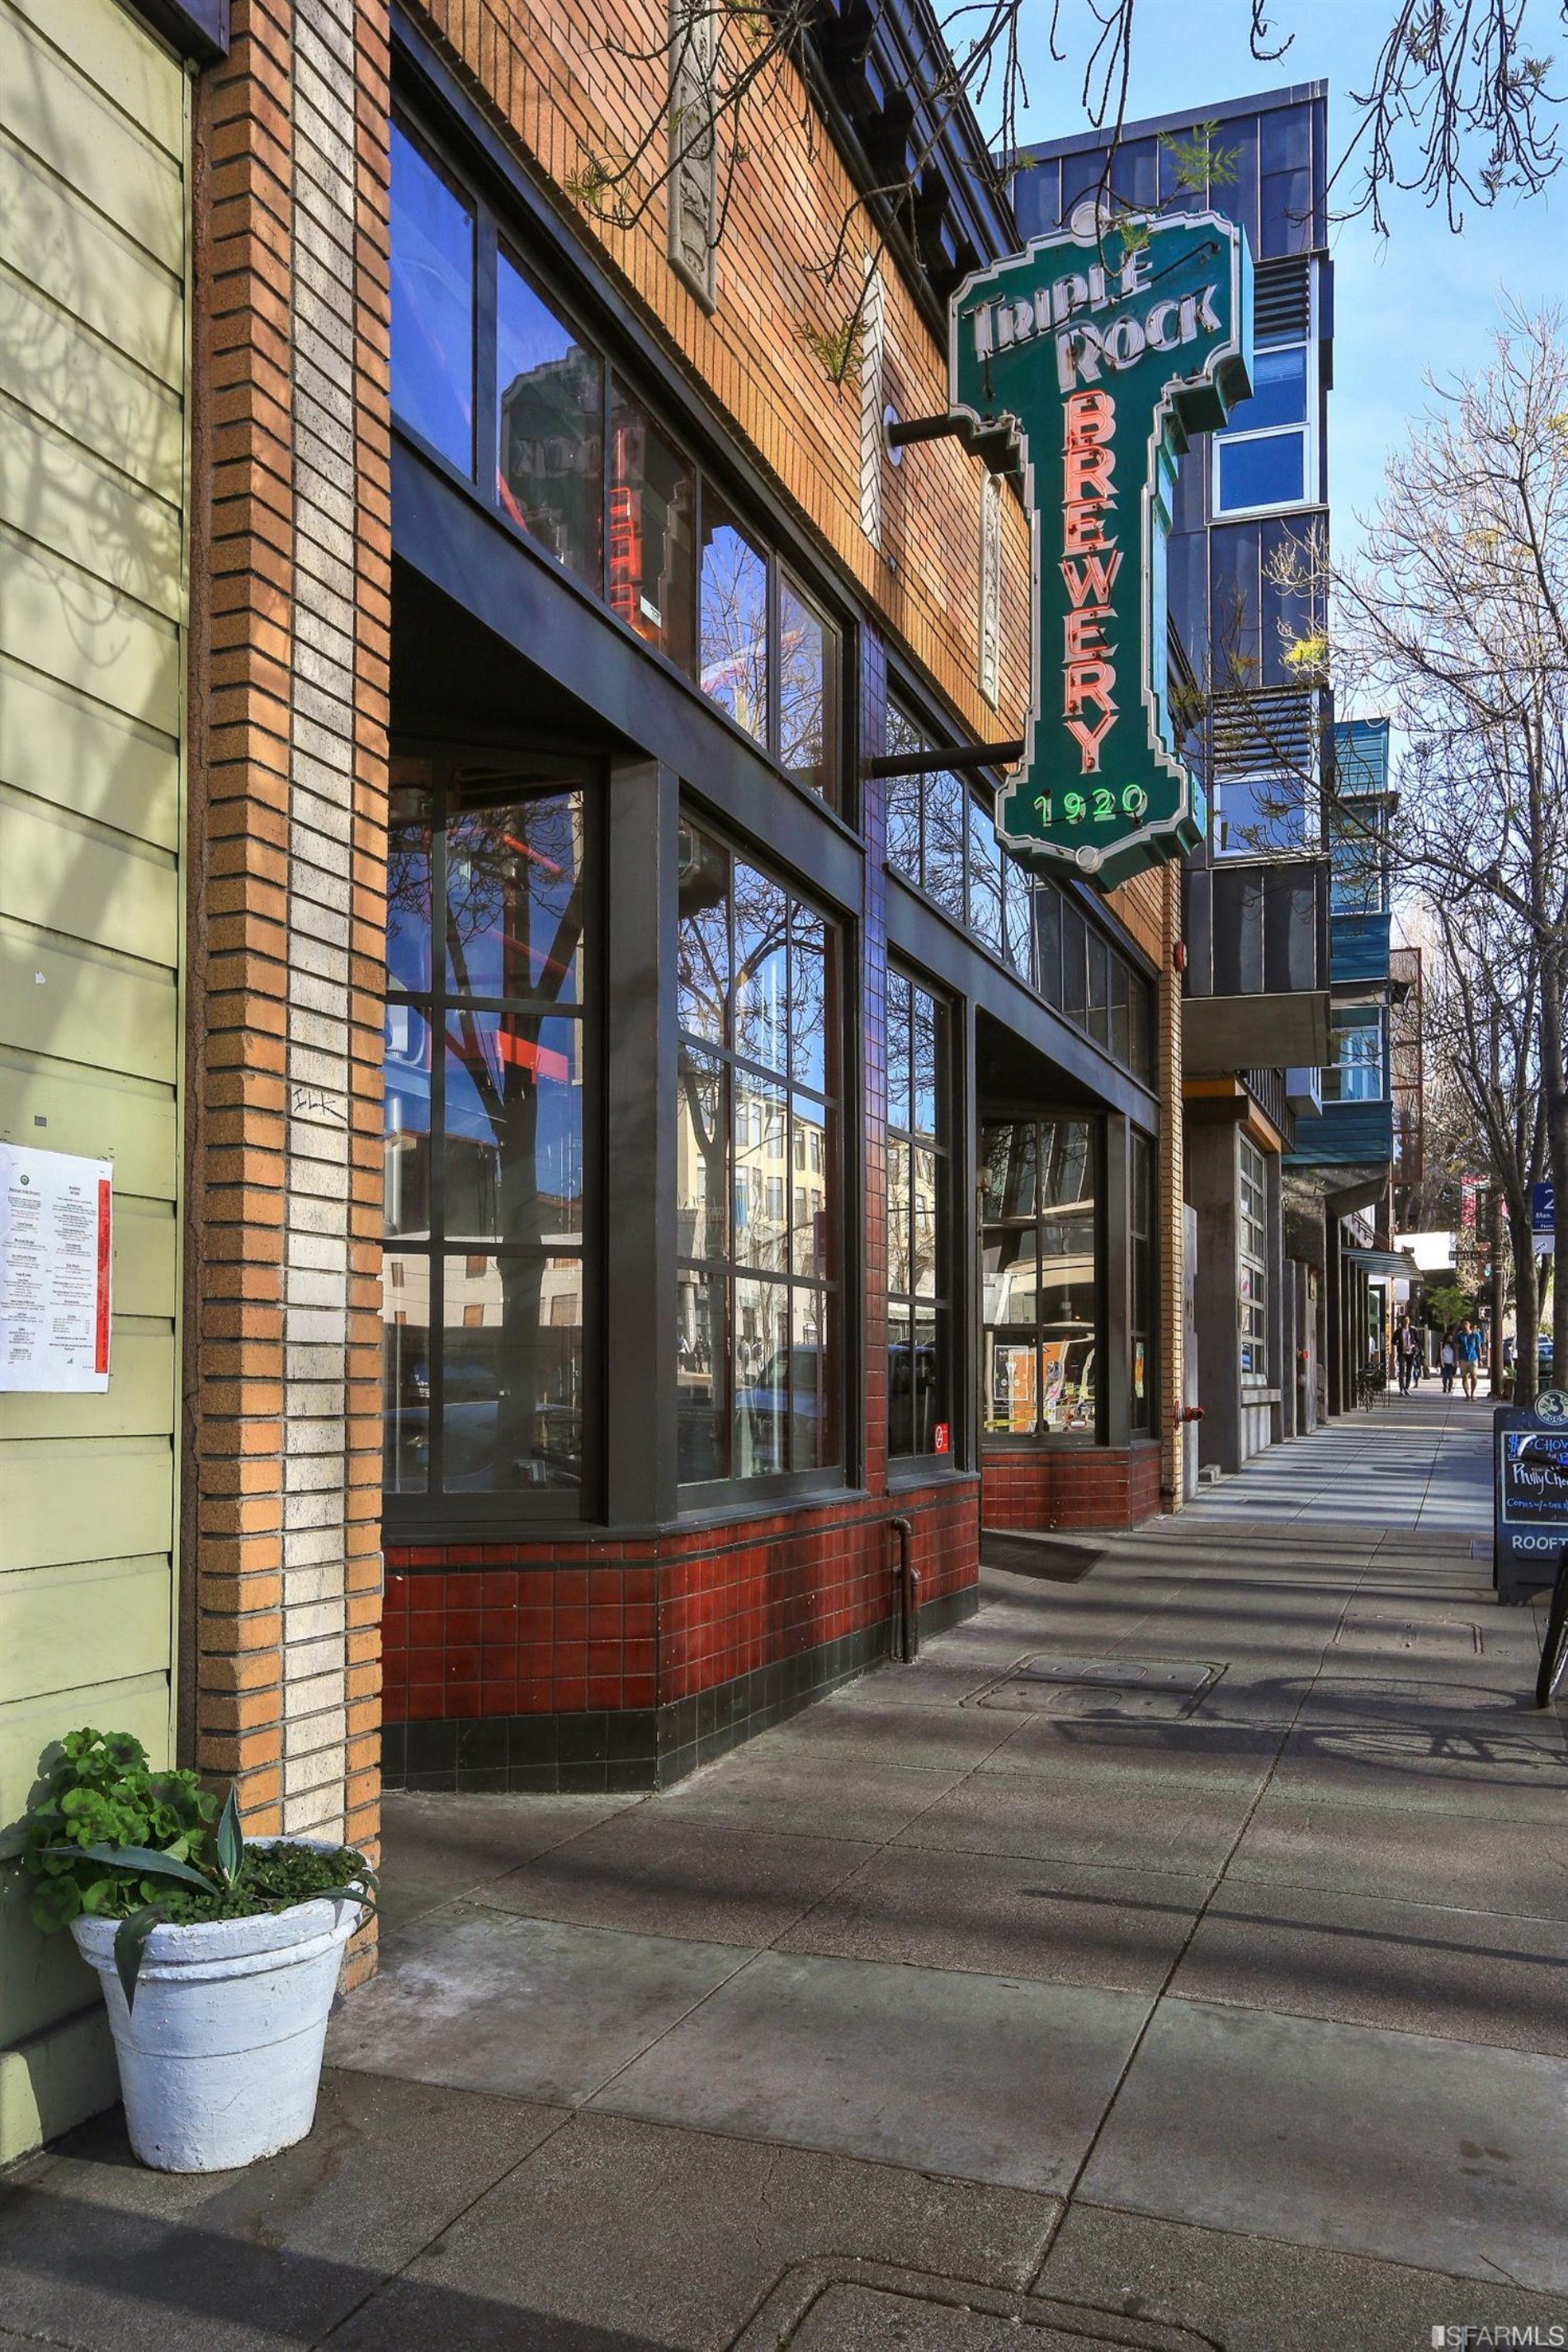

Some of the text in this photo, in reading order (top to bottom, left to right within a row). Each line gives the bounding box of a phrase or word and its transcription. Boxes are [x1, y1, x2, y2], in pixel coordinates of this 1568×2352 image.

[961, 247, 1153, 362] TRIPLE
[1056, 283, 1221, 394] ROCK
[1058, 390, 1124, 775] BREWERY
[1033, 784, 1149, 828] 1920
[1542, 1412, 1567, 1423] ROCK
[1548, 1394, 1564, 1416] 3
[1512, 1462, 1568, 1495] Philly Che
[1512, 1536, 1568, 1550] ROOFT
